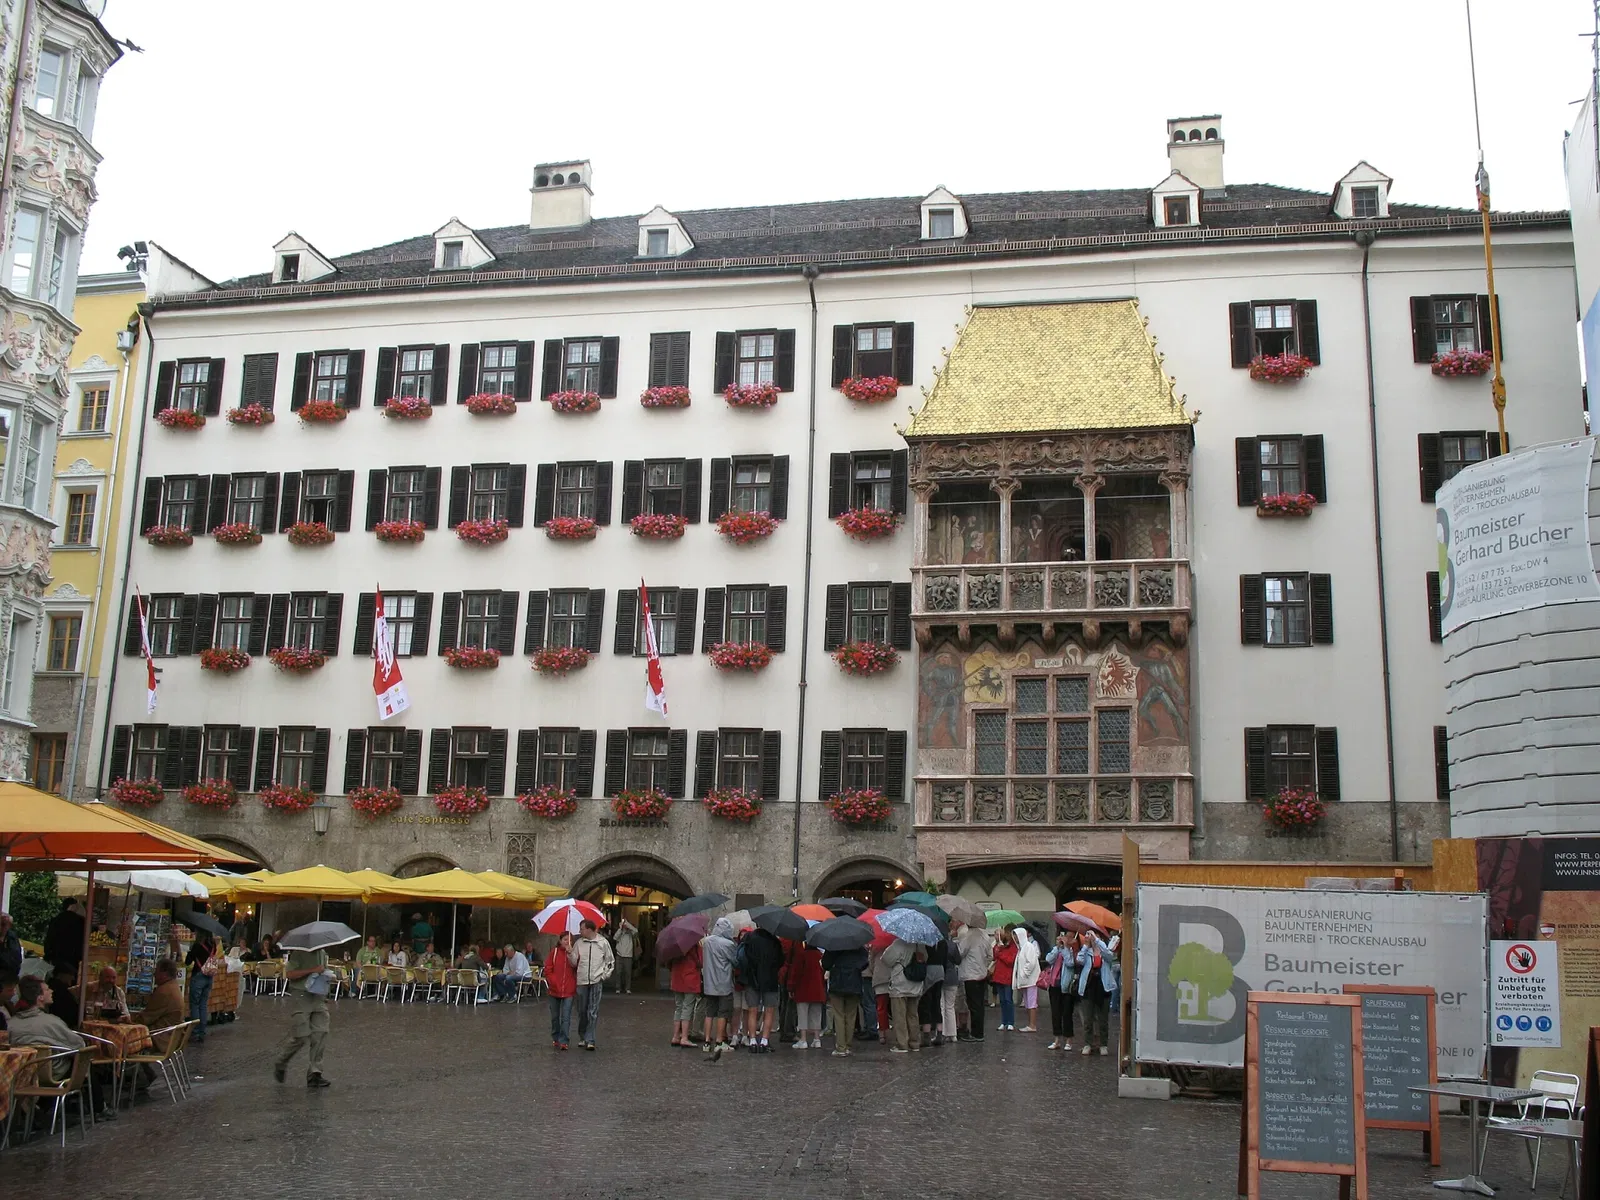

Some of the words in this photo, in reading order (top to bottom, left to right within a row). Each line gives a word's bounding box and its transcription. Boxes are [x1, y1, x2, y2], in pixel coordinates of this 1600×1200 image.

[1476, 486, 1541, 511] TROCKENAUSBAU
[1454, 512, 1526, 545] Baumeister
[1455, 537, 1503, 566] Gerhard
[1508, 526, 1574, 551] Bucher
[1496, 566, 1505, 576] 75
[1527, 558, 1541, 569] DW
[1543, 557, 1549, 565] 4
[1481, 581, 1492, 591] 133
[1494, 578, 1502, 587] 72
[1503, 576, 1513, 586] 52
[1507, 576, 1573, 596] GEWERBEZONE
[1577, 575, 1587, 584] 10
[1555, 852, 1578, 860] INFOS:
[1580, 852, 1593, 860] TEL.
[1265, 909, 1372, 921] ALTBAUSANIERUNG
[1265, 921, 1373, 933] BAUUNTERNEHMEN
[1265, 933, 1316, 944] ZIMMEREI
[1328, 935, 1427, 947] TROCKENAUSBAU
[1264, 953, 1404, 976] Baumeister
[1498, 976, 1528, 984] Zutritt
[1531, 976, 1545, 984] für
[1498, 984, 1546, 993] Unbefugte
[1496, 1033, 1504, 1042] B
[1462, 1048, 1474, 1057] 10
